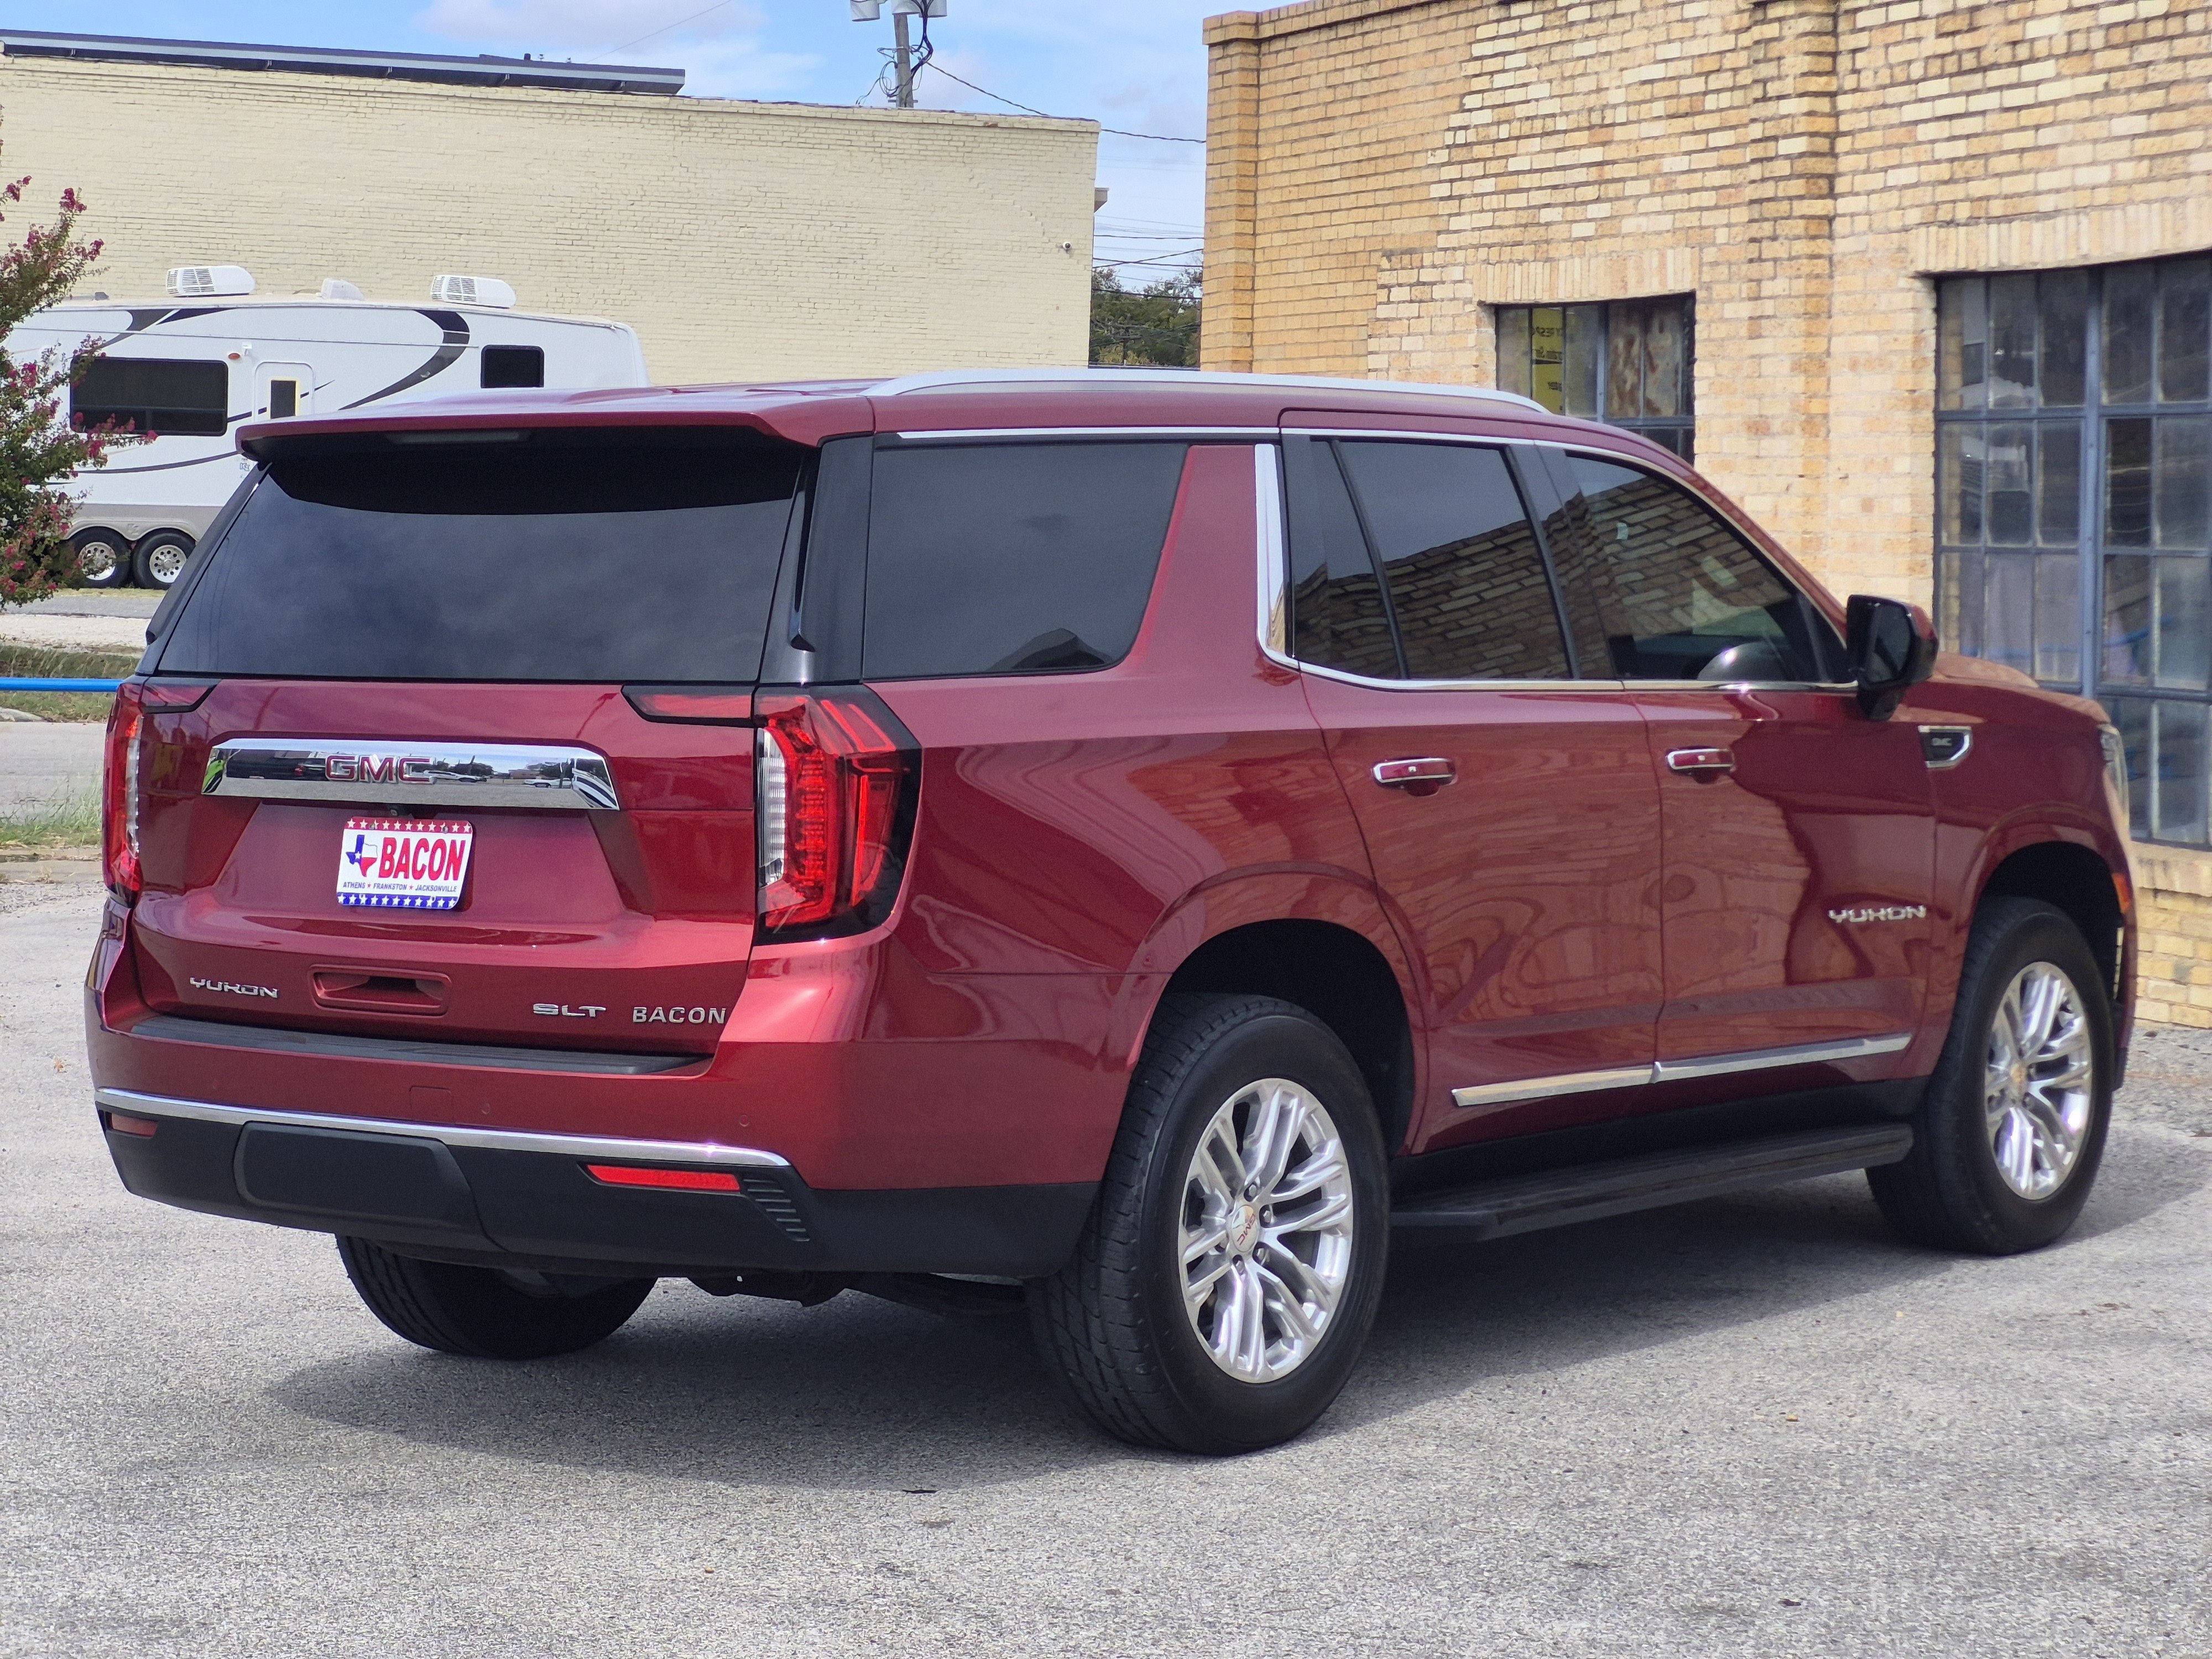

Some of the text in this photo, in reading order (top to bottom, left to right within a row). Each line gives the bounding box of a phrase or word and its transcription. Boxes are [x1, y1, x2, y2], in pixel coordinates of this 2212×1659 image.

[325, 754, 437, 784] GMC
[378, 837, 466, 881] BACON
[415, 884, 457, 893] JACKSONVILLE
[1828, 905, 1927, 923] YUKON
[189, 977, 278, 999] YUKON
[533, 1003, 607, 1018] SLT
[632, 1006, 727, 1024] BACON
[1237, 1213, 1256, 1245] GMC
